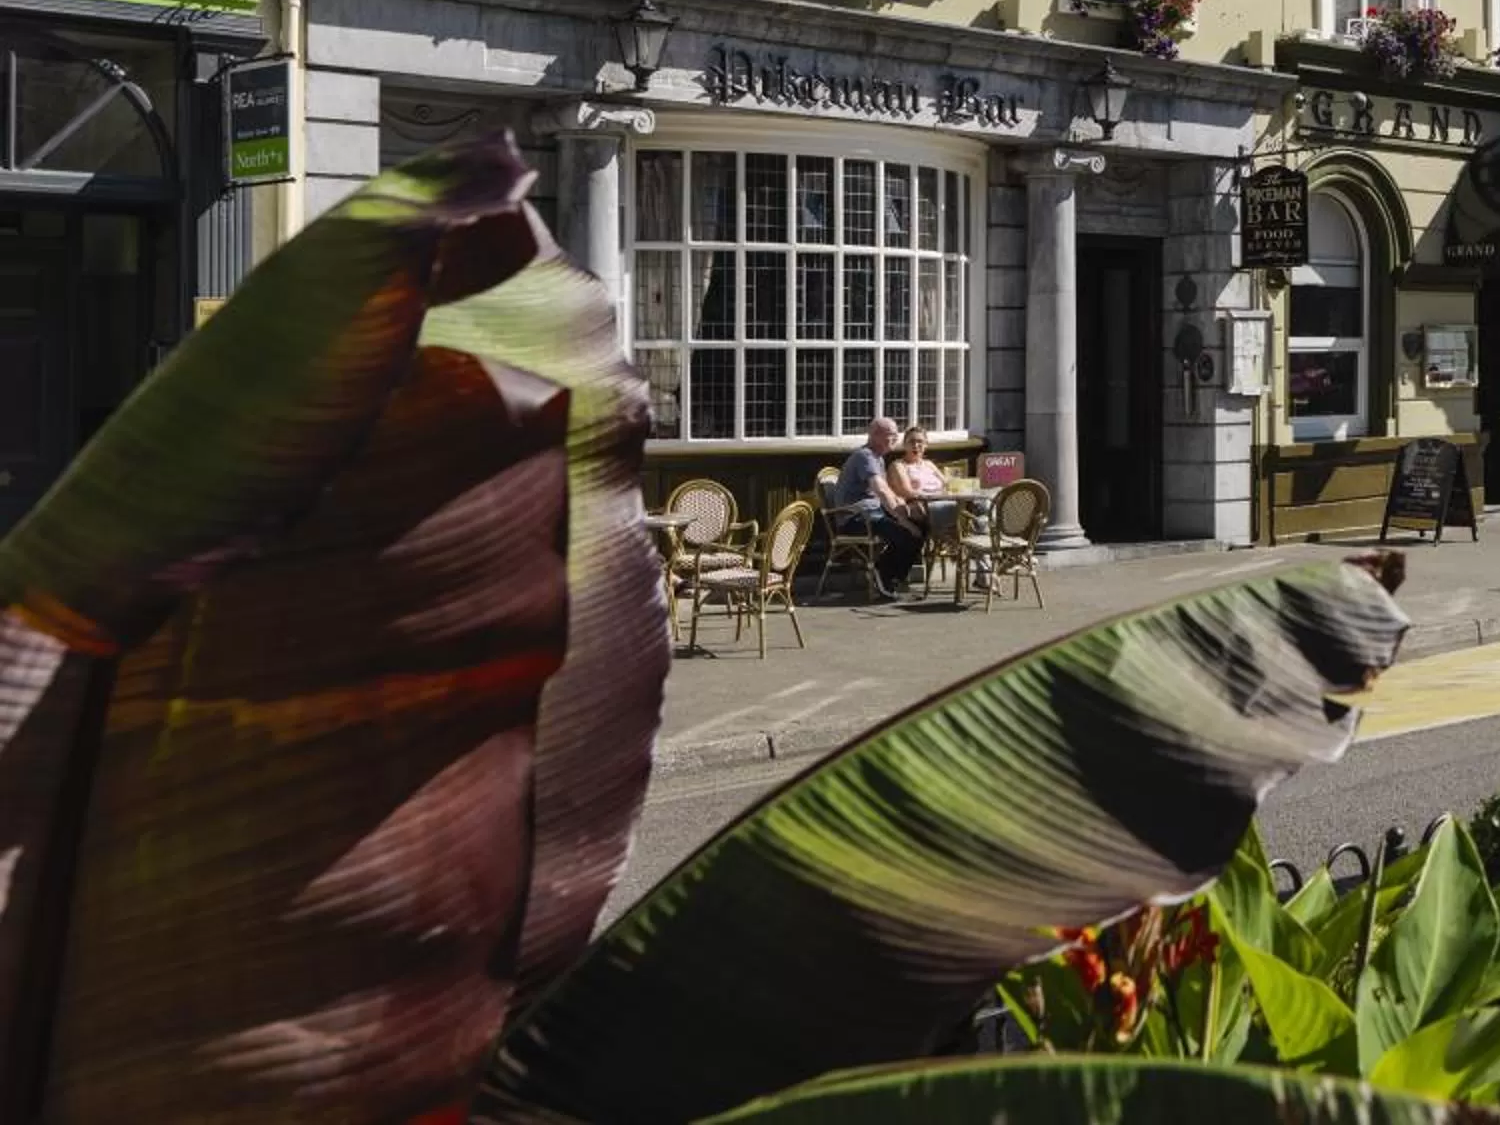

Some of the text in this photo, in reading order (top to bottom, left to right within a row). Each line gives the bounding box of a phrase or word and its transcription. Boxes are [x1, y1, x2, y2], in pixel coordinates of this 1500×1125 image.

[703, 41, 1026, 125] Pikeman Bar
[233, 91, 255, 109] REA
[1311, 90, 1483, 147] GRAND
[1246, 186, 1302, 204] PIKEMAN
[1247, 201, 1302, 224] BAR
[1255, 228, 1294, 240] FOOD
[1447, 242, 1496, 259] GRAND
